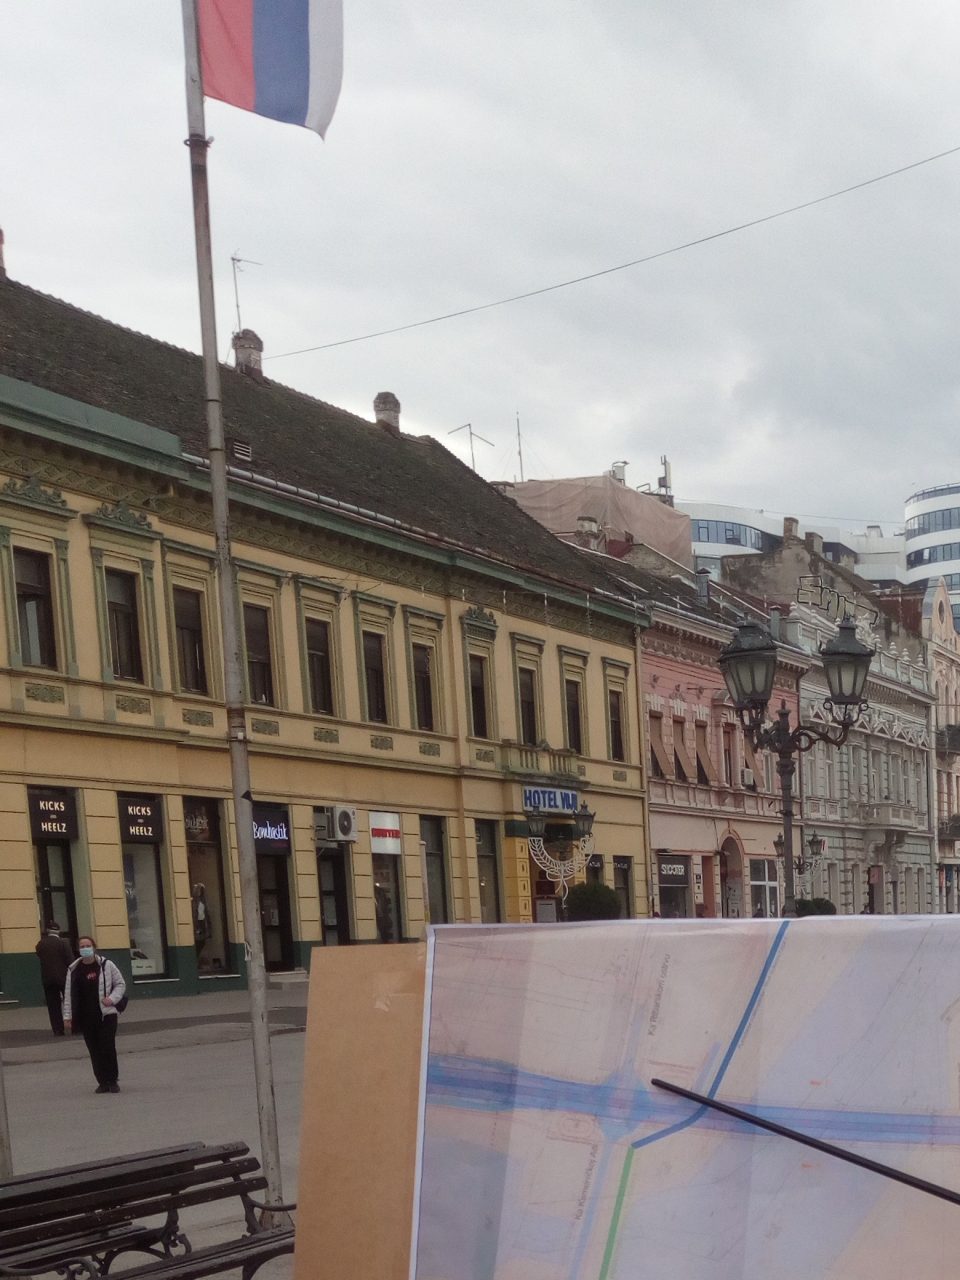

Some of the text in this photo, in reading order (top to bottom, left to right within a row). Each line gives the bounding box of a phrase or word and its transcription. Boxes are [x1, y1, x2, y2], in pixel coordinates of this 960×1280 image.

[524, 789, 559, 808] HOTEL
[39, 801, 65, 811] KICKS
[127, 805, 152, 816] KICKS
[41, 822, 67, 833] HEELZ
[129, 826, 153, 836] HEELZ
